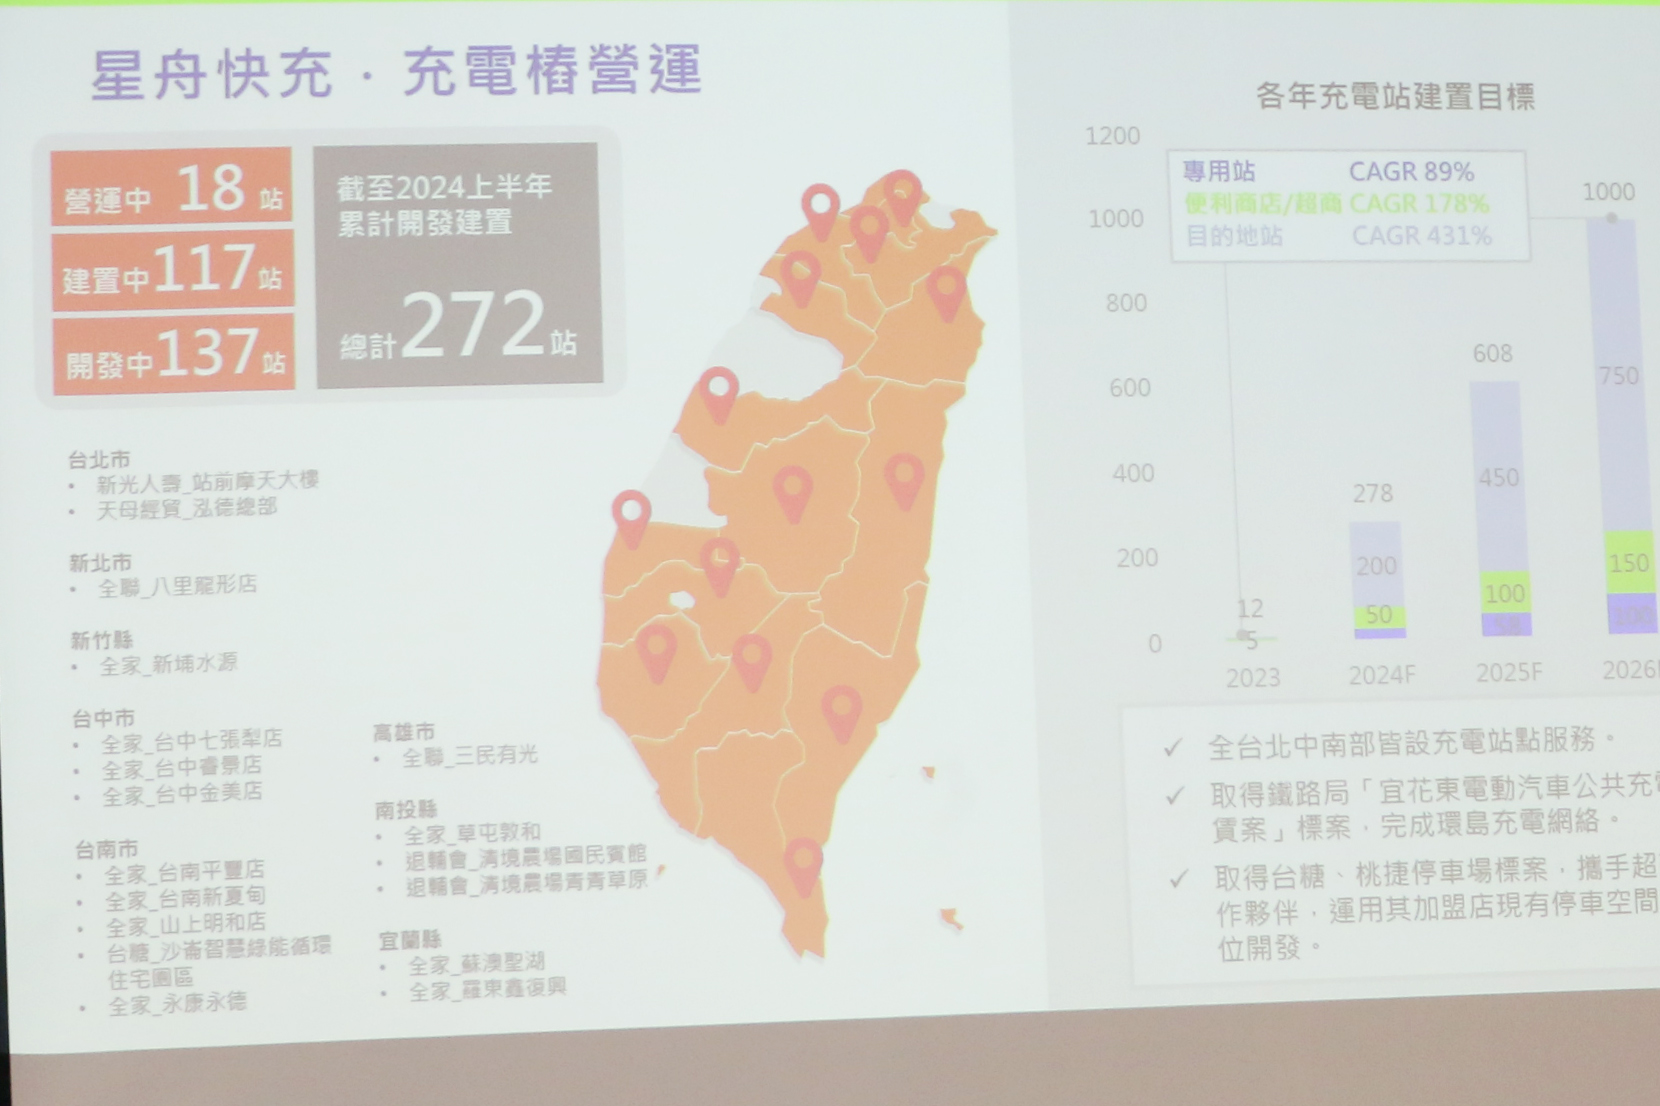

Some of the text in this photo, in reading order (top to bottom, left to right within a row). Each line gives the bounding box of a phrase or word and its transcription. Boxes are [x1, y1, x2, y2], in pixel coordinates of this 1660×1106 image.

[1256, 81, 1536, 112] 各年充電站建置目標
[1086, 125, 1141, 147] 1200
[1182, 159, 1476, 183] 專用站 CAGR 89%
[177, 163, 245, 212] 18
[336, 173, 553, 203] 截至2024上半年
[1583, 181, 1636, 202] 1000
[1349, 193, 1418, 214] CAGR
[1425, 192, 1491, 214] 178%
[338, 208, 513, 238] 累計開發建置
[1089, 208, 1144, 230] 1000
[1187, 224, 1493, 248] 目的地站 CAGR 431%
[1106, 293, 1148, 314] 800
[1473, 343, 1513, 364] 608
[1599, 365, 1639, 387] 750
[1109, 377, 1151, 398] 600
[68, 449, 132, 471] 台北市
[1112, 463, 1155, 484] 400
[1479, 467, 1520, 488] 450
[1353, 483, 1394, 504] 278
[69, 553, 133, 574] 新北市
[1116, 548, 1159, 569] 200
[1356, 555, 1398, 577] 200
[1609, 552, 1650, 574] 150
[1485, 583, 1526, 604] 100
[1238, 598, 1264, 618] 12
[1365, 604, 1393, 625] 50
[70, 629, 134, 651] 新竹縣
[1148, 633, 1163, 654] 0
[1226, 667, 1281, 688] 2023
[1348, 664, 1416, 687] 2024F
[1476, 662, 1543, 684] 2025F
[72, 708, 136, 729] 台中市
[373, 722, 436, 743] 高雄市
[375, 799, 438, 821] 南投縣
[75, 839, 139, 860] 台南市
[379, 929, 444, 952] 宜蘭縣
[107, 965, 194, 991] 住宅園區
